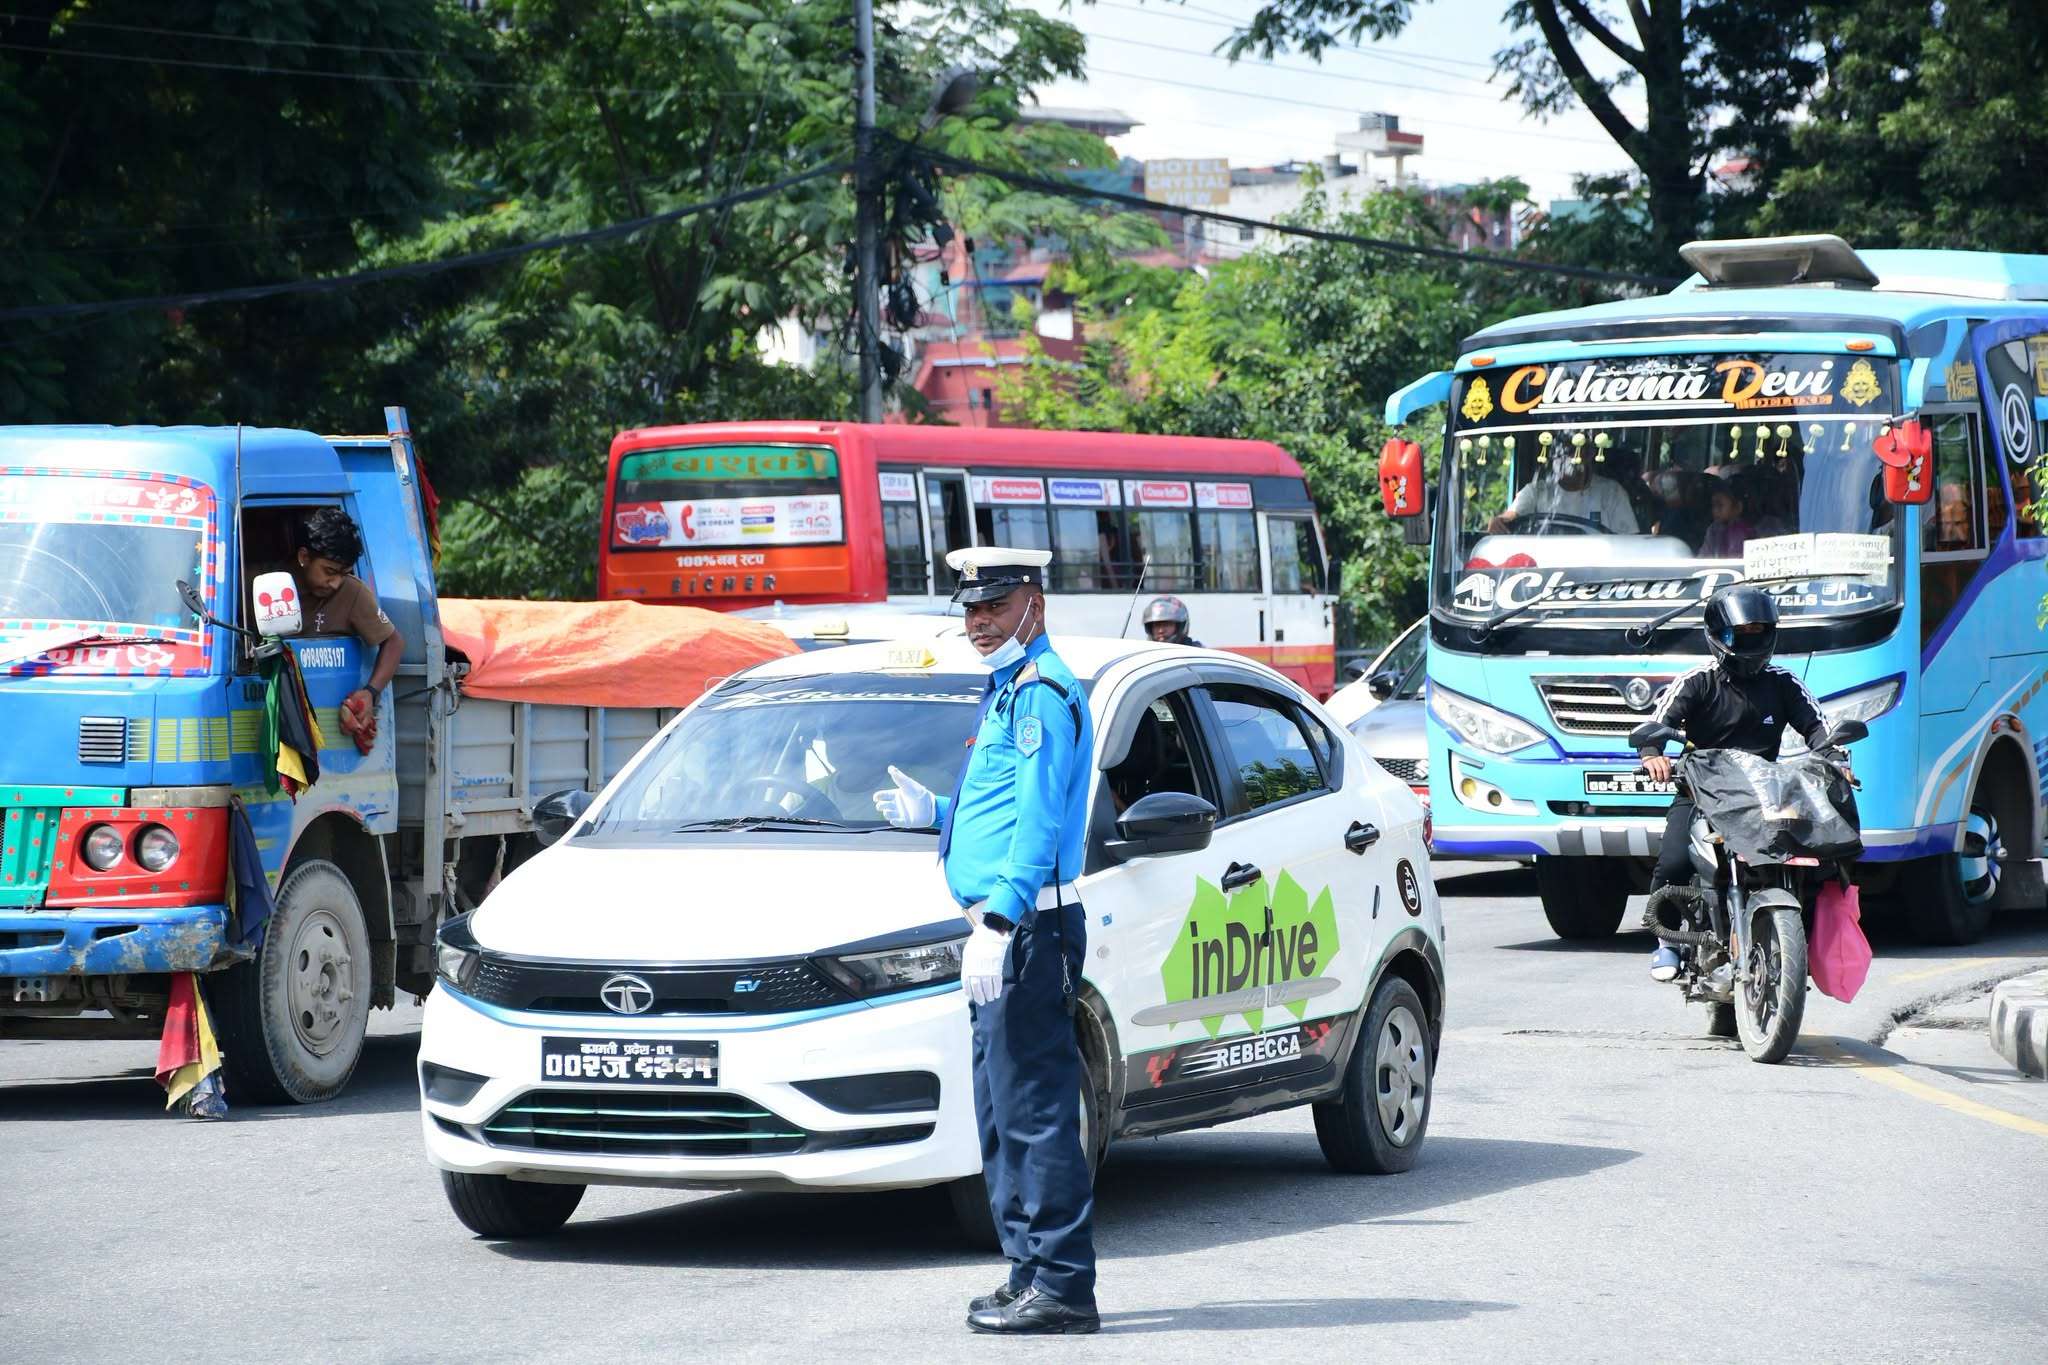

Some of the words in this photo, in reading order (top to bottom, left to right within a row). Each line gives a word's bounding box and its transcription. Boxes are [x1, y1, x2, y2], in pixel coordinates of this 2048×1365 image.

[1148, 159, 1230, 175] HOTEL
[1148, 176, 1229, 190] CRYSTAL
[1167, 191, 1212, 206] VIEW
[1500, 362, 1711, 413] Chhema
[1715, 360, 1834, 407] Devi
[1754, 396, 1832, 408] DELUXE
[671, 574, 776, 593] EICHER
[1498, 571, 1690, 610] Chema
[887, 649, 921, 664] TAXI
[1190, 921, 1318, 1000] inDrive
[733, 979, 762, 993] EV
[1216, 1035, 1301, 1068] REBECCA
